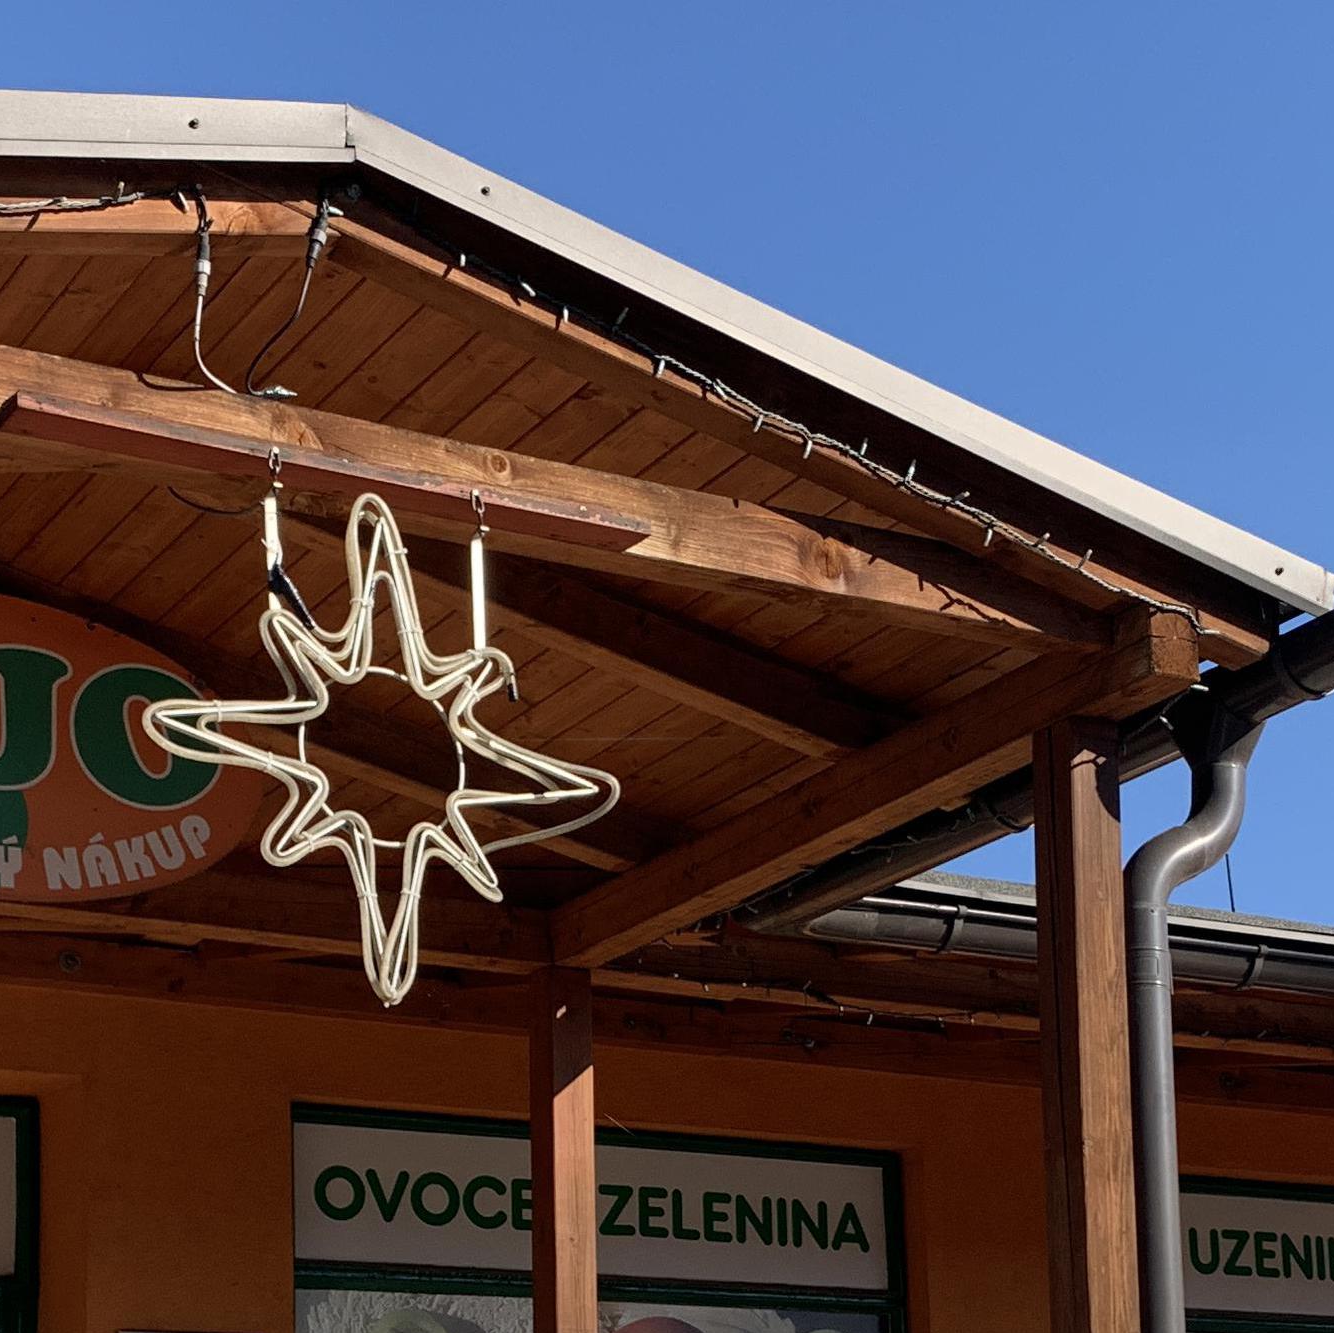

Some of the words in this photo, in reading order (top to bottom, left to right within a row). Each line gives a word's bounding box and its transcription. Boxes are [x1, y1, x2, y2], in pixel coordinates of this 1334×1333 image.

[44, 815, 212, 890] NÁKUP
[314, 1165, 534, 1230] OVOCE
[598, 1184, 870, 1253] ZELENINA
